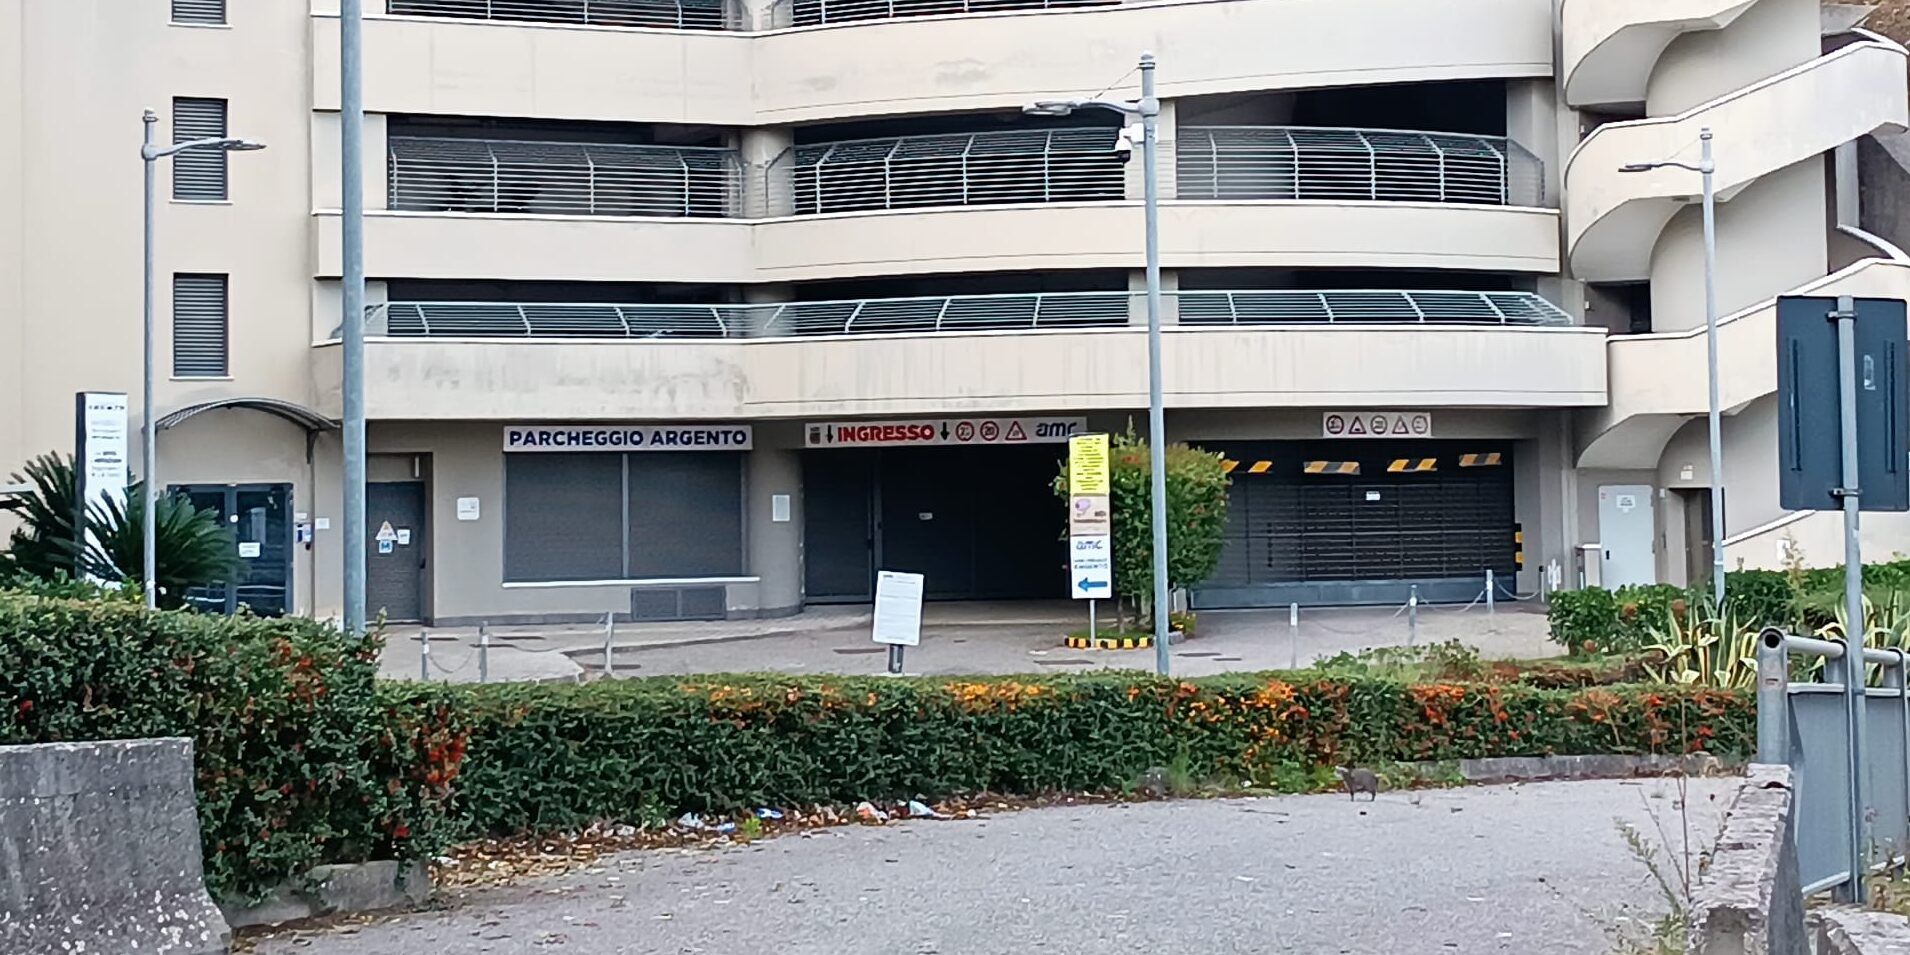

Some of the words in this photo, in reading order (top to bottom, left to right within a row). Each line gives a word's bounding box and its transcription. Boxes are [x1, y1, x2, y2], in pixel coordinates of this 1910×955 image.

[509, 430, 644, 446] PARCHEGGIO
[650, 430, 747, 445] ARGENTO
[837, 424, 935, 442] INGRESSO
